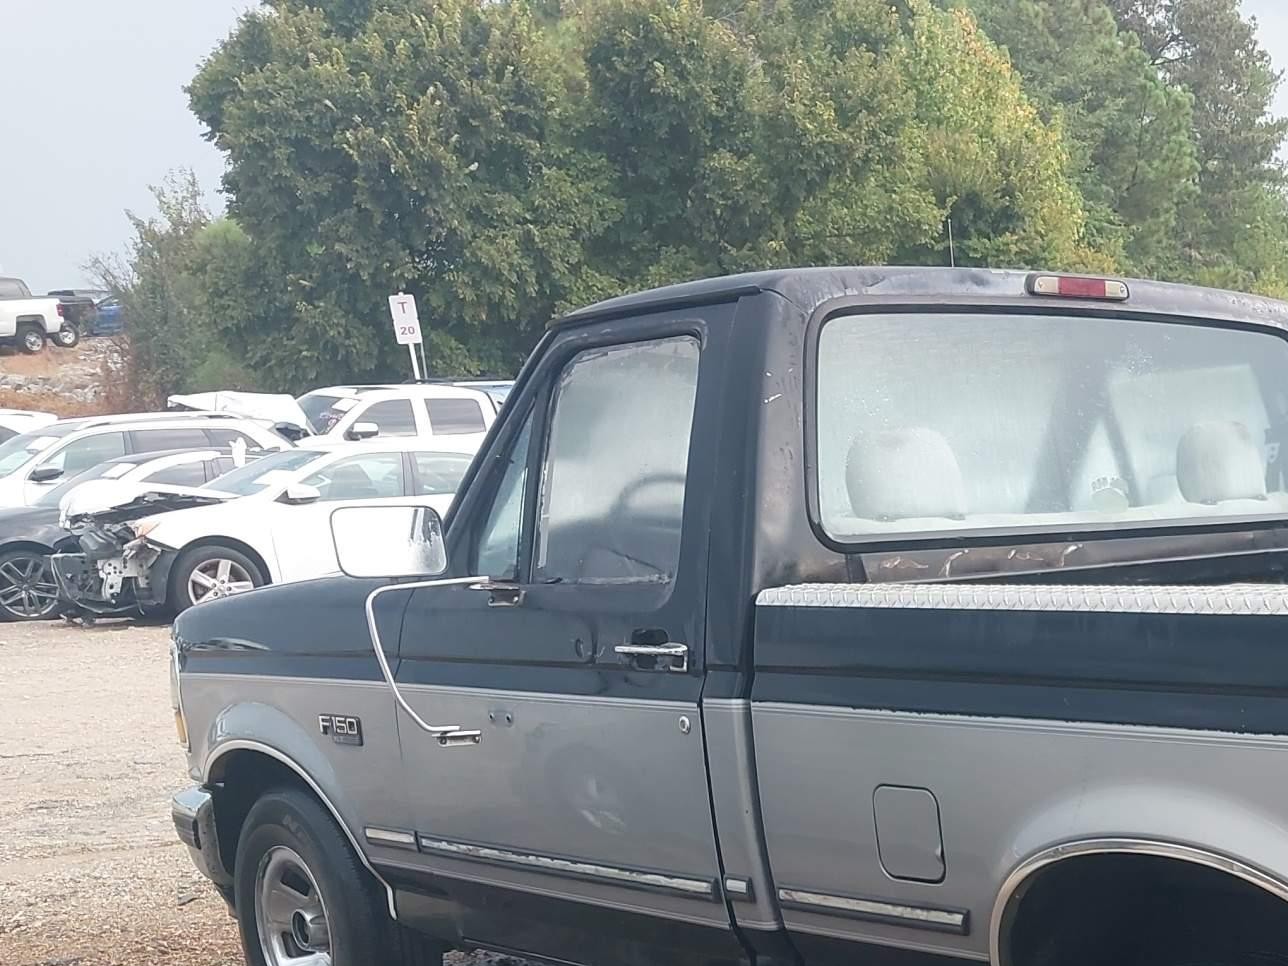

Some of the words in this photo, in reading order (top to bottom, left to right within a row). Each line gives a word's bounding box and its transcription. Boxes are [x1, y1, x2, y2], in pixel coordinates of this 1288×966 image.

[397, 301, 408, 314] T
[400, 326, 415, 336] 20
[318, 715, 358, 735] F150
